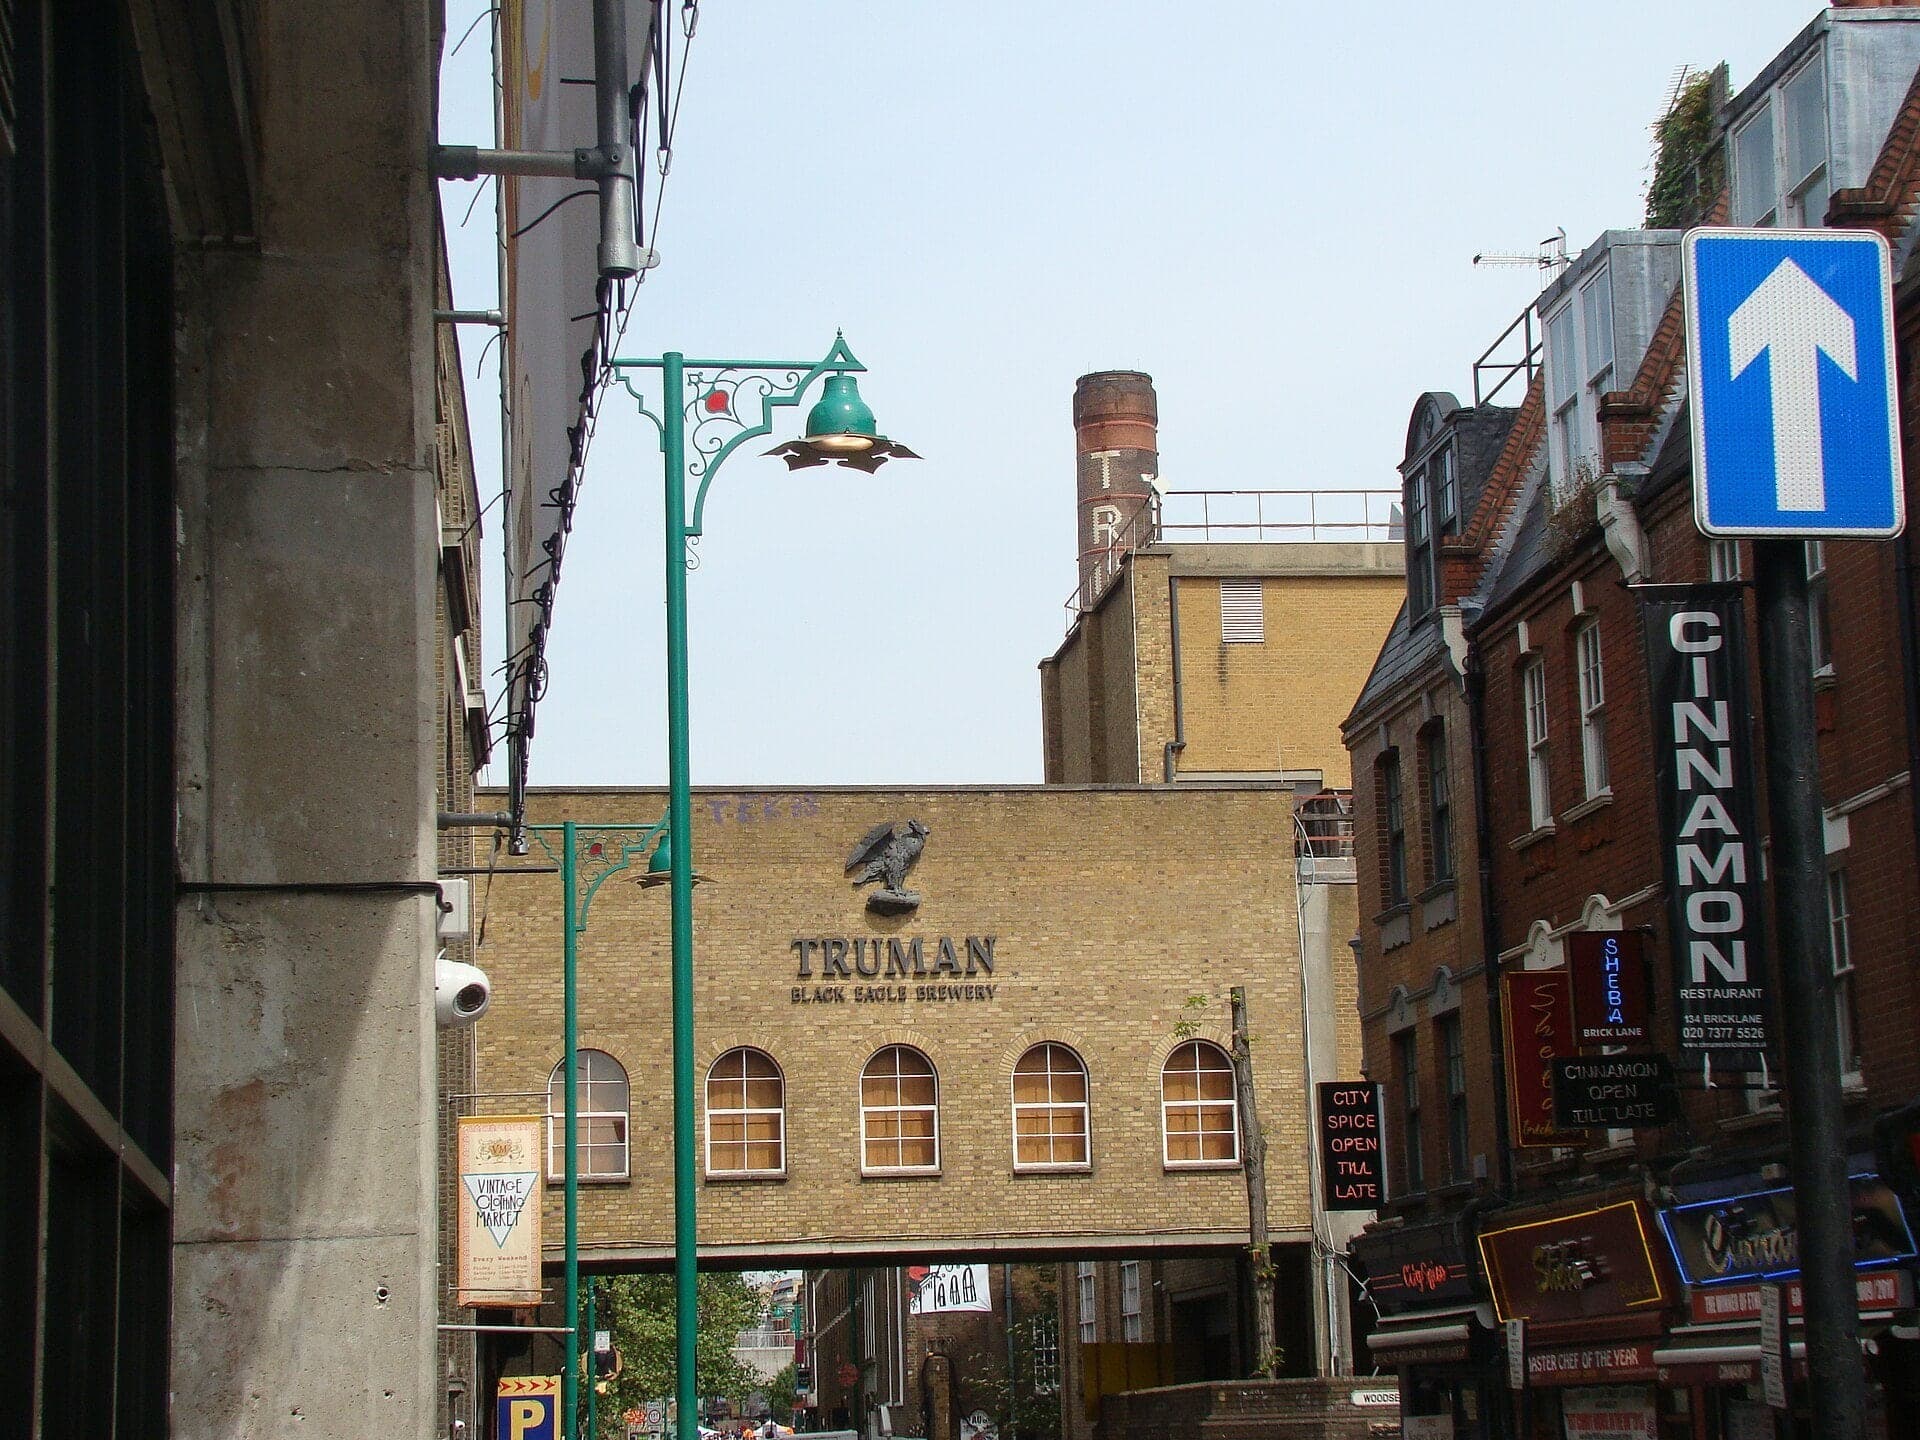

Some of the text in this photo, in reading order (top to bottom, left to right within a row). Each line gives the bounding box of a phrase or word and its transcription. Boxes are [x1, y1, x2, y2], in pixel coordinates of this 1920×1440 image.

[1670, 611, 1746, 983] CINNAMON
[791, 935, 997, 977] TRUMAN
[1605, 939, 1623, 1024] SHEBA
[791, 983, 998, 1004] BLACK EAGLE BREWERY
[1680, 988, 1763, 999] RESTAURANT
[1684, 1014, 1701, 1024] 134
[1583, 1027, 1643, 1037] BRICK LANE
[1682, 1027, 1765, 1039] 020 7377 5526
[1564, 1062, 1658, 1080] CINNAMON
[1333, 1090, 1370, 1105] CITY
[1589, 1084, 1639, 1101] OPEN
[1614, 1103, 1657, 1121] LATE
[1328, 1114, 1376, 1129] SPICE
[1331, 1137, 1377, 1152] OPEN
[478, 1178, 522, 1194] VINTAGE
[1335, 1183, 1377, 1198] LATE
[476, 1194, 525, 1211] CLOTHING
[476, 1210, 522, 1228] MARKET
[1559, 1352, 1579, 1369] CHEF
[1582, 1350, 1594, 1369] OF
[1596, 1349, 1613, 1367] THE
[1614, 1347, 1639, 1365] YEAR
[511, 1400, 546, 1440] P
